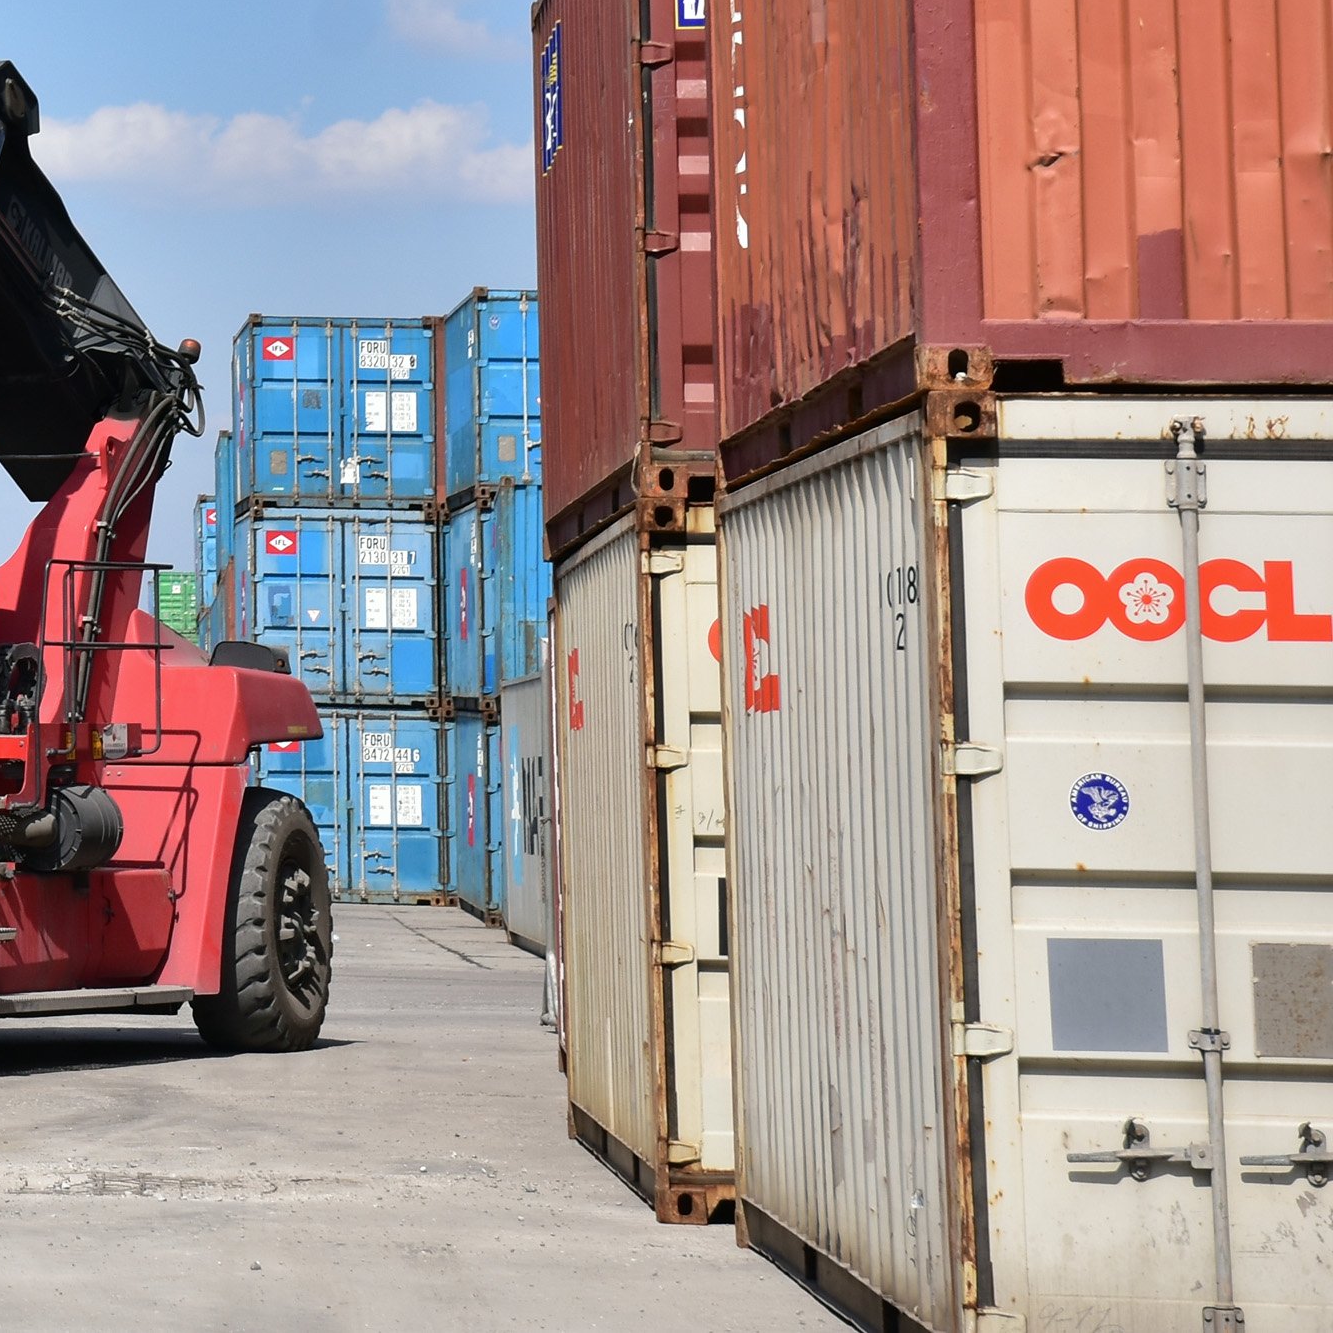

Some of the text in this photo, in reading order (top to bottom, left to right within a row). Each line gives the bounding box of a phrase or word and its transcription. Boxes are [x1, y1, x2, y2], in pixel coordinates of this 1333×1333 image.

[361, 342, 404, 367] FORU 8320 32
[360, 537, 386, 549] FORU
[360, 552, 386, 564] 2130
[392, 552, 405, 564] 31
[1025, 557, 1332, 642] OOCL
[364, 734, 391, 747] FORU
[395, 749, 409, 761] 44
[1071, 774, 1128, 829] AMERICAN BUREAU OF SHIPPING
